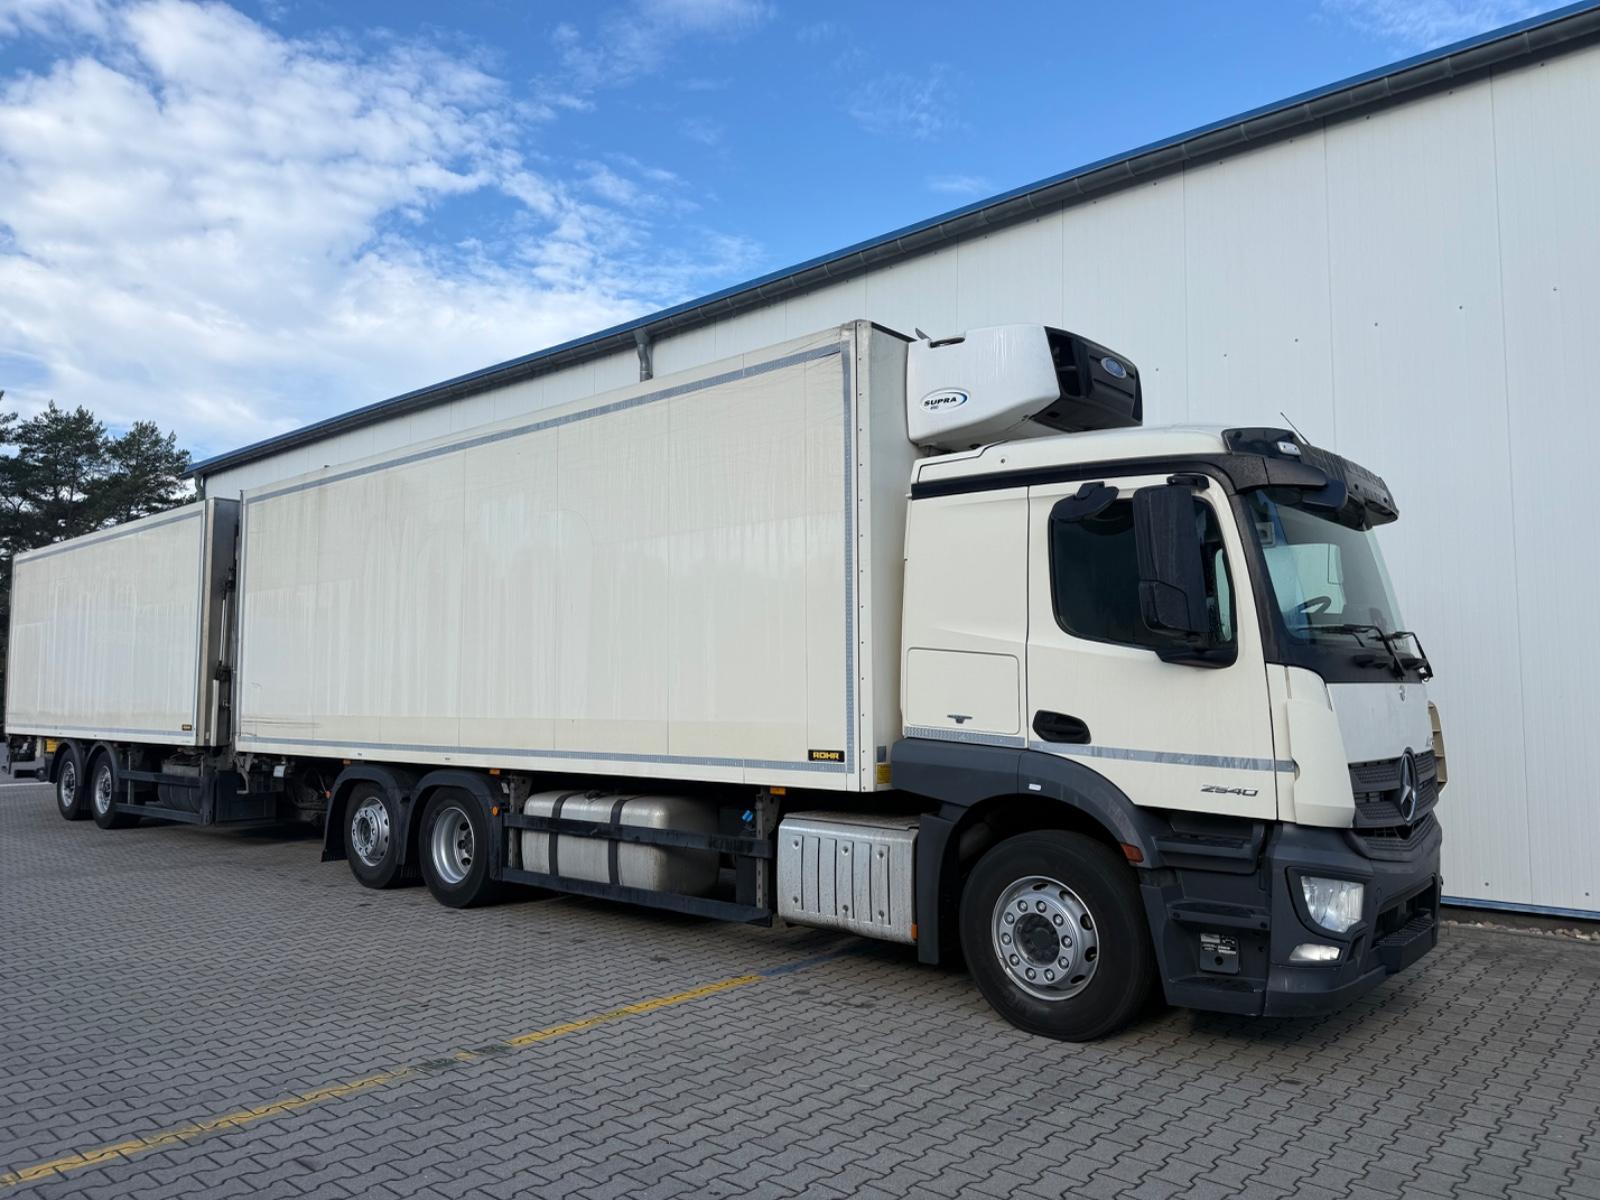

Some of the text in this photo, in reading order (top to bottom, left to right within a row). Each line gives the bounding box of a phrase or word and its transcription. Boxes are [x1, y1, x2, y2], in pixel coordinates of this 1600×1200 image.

[923, 396, 958, 407] SUPRA
[812, 751, 840, 760] ROHR
[1200, 784, 1259, 798] 2540
